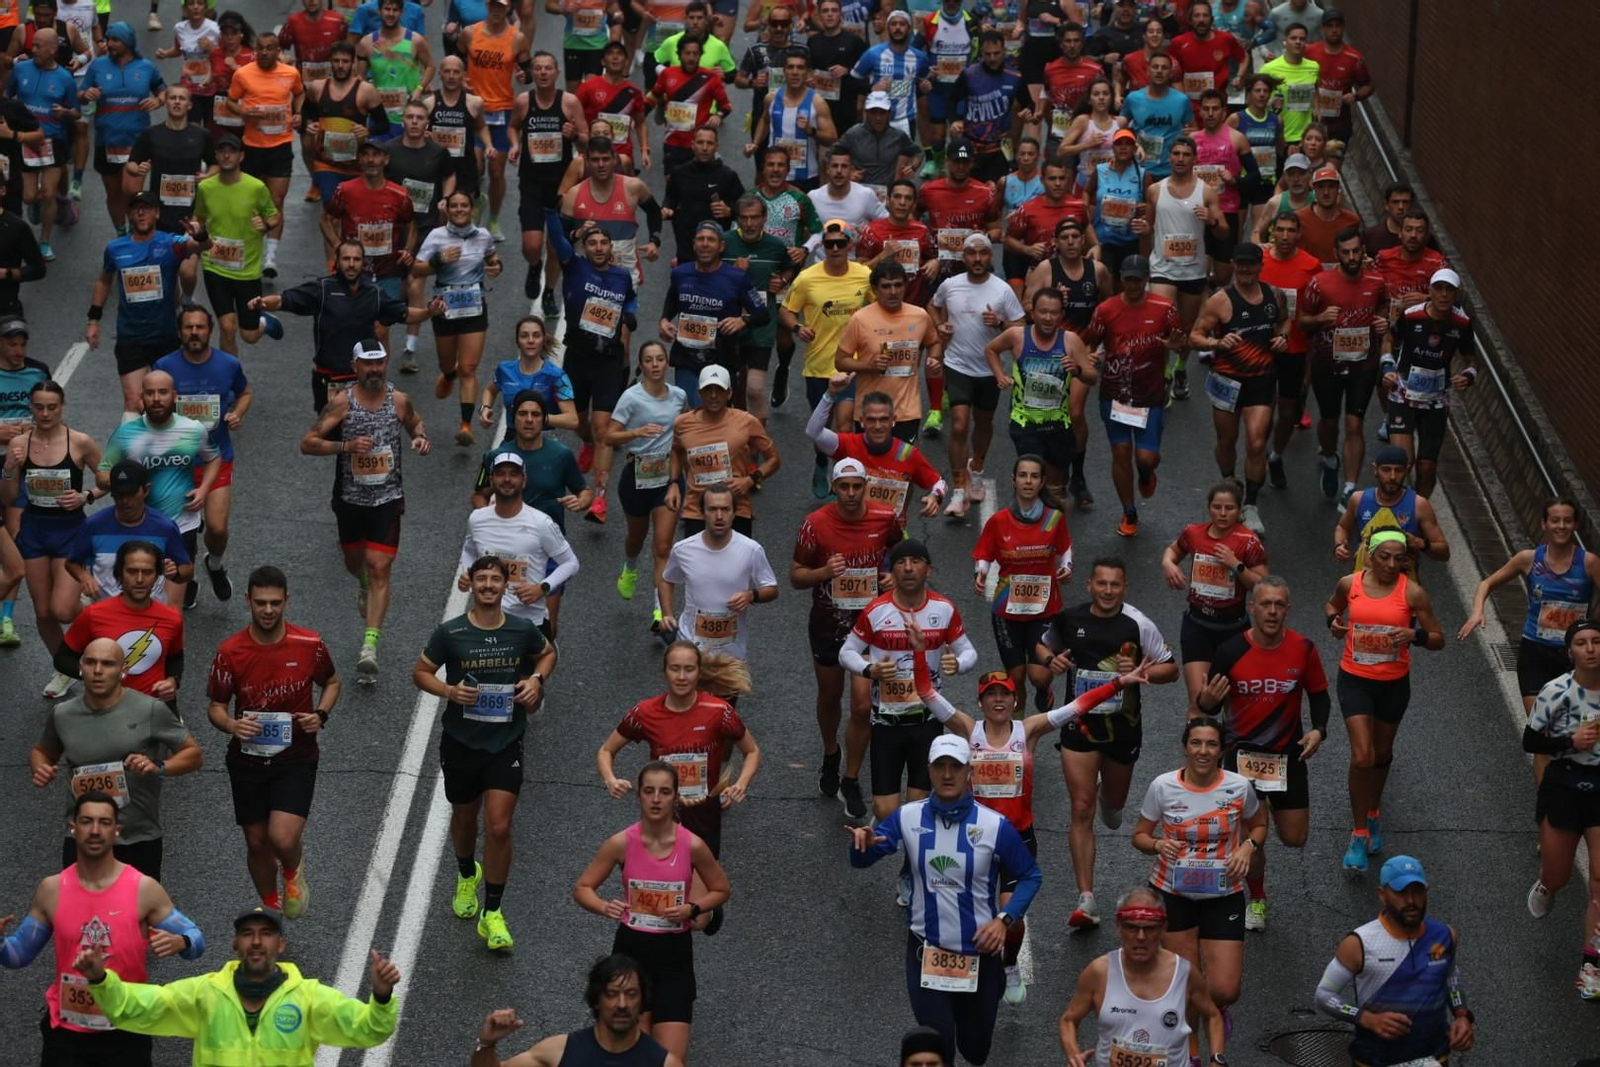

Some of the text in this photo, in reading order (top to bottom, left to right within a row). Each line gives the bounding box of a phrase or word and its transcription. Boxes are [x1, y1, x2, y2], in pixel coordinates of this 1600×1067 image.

[533, 139, 555, 149] 5566
[165, 182, 187, 192] 6204
[1169, 241, 1191, 252] 4530
[128, 276, 152, 287] 6024
[679, 293, 723, 308] ESTUTIENDA
[589, 306, 613, 322] 4824
[683, 323, 707, 336] 4839
[1340, 336, 1362, 347] 5343
[358, 456, 384, 468] 5391
[695, 454, 720, 467] 4791
[869, 486, 896, 500] 6307
[1199, 565, 1225, 580] 6263
[840, 579, 867, 591] 5071
[1014, 584, 1040, 597] 6302
[701, 619, 729, 633] 4387
[461, 657, 521, 669] MARBELLA
[885, 683, 913, 695] 3694
[1244, 760, 1274, 774] 4925
[79, 776, 113, 792] 5236
[637, 891, 669, 906] 4271
[931, 952, 966, 969] 3833
[69, 987, 95, 1006] 353
[1115, 1052, 1151, 1067] 5522
